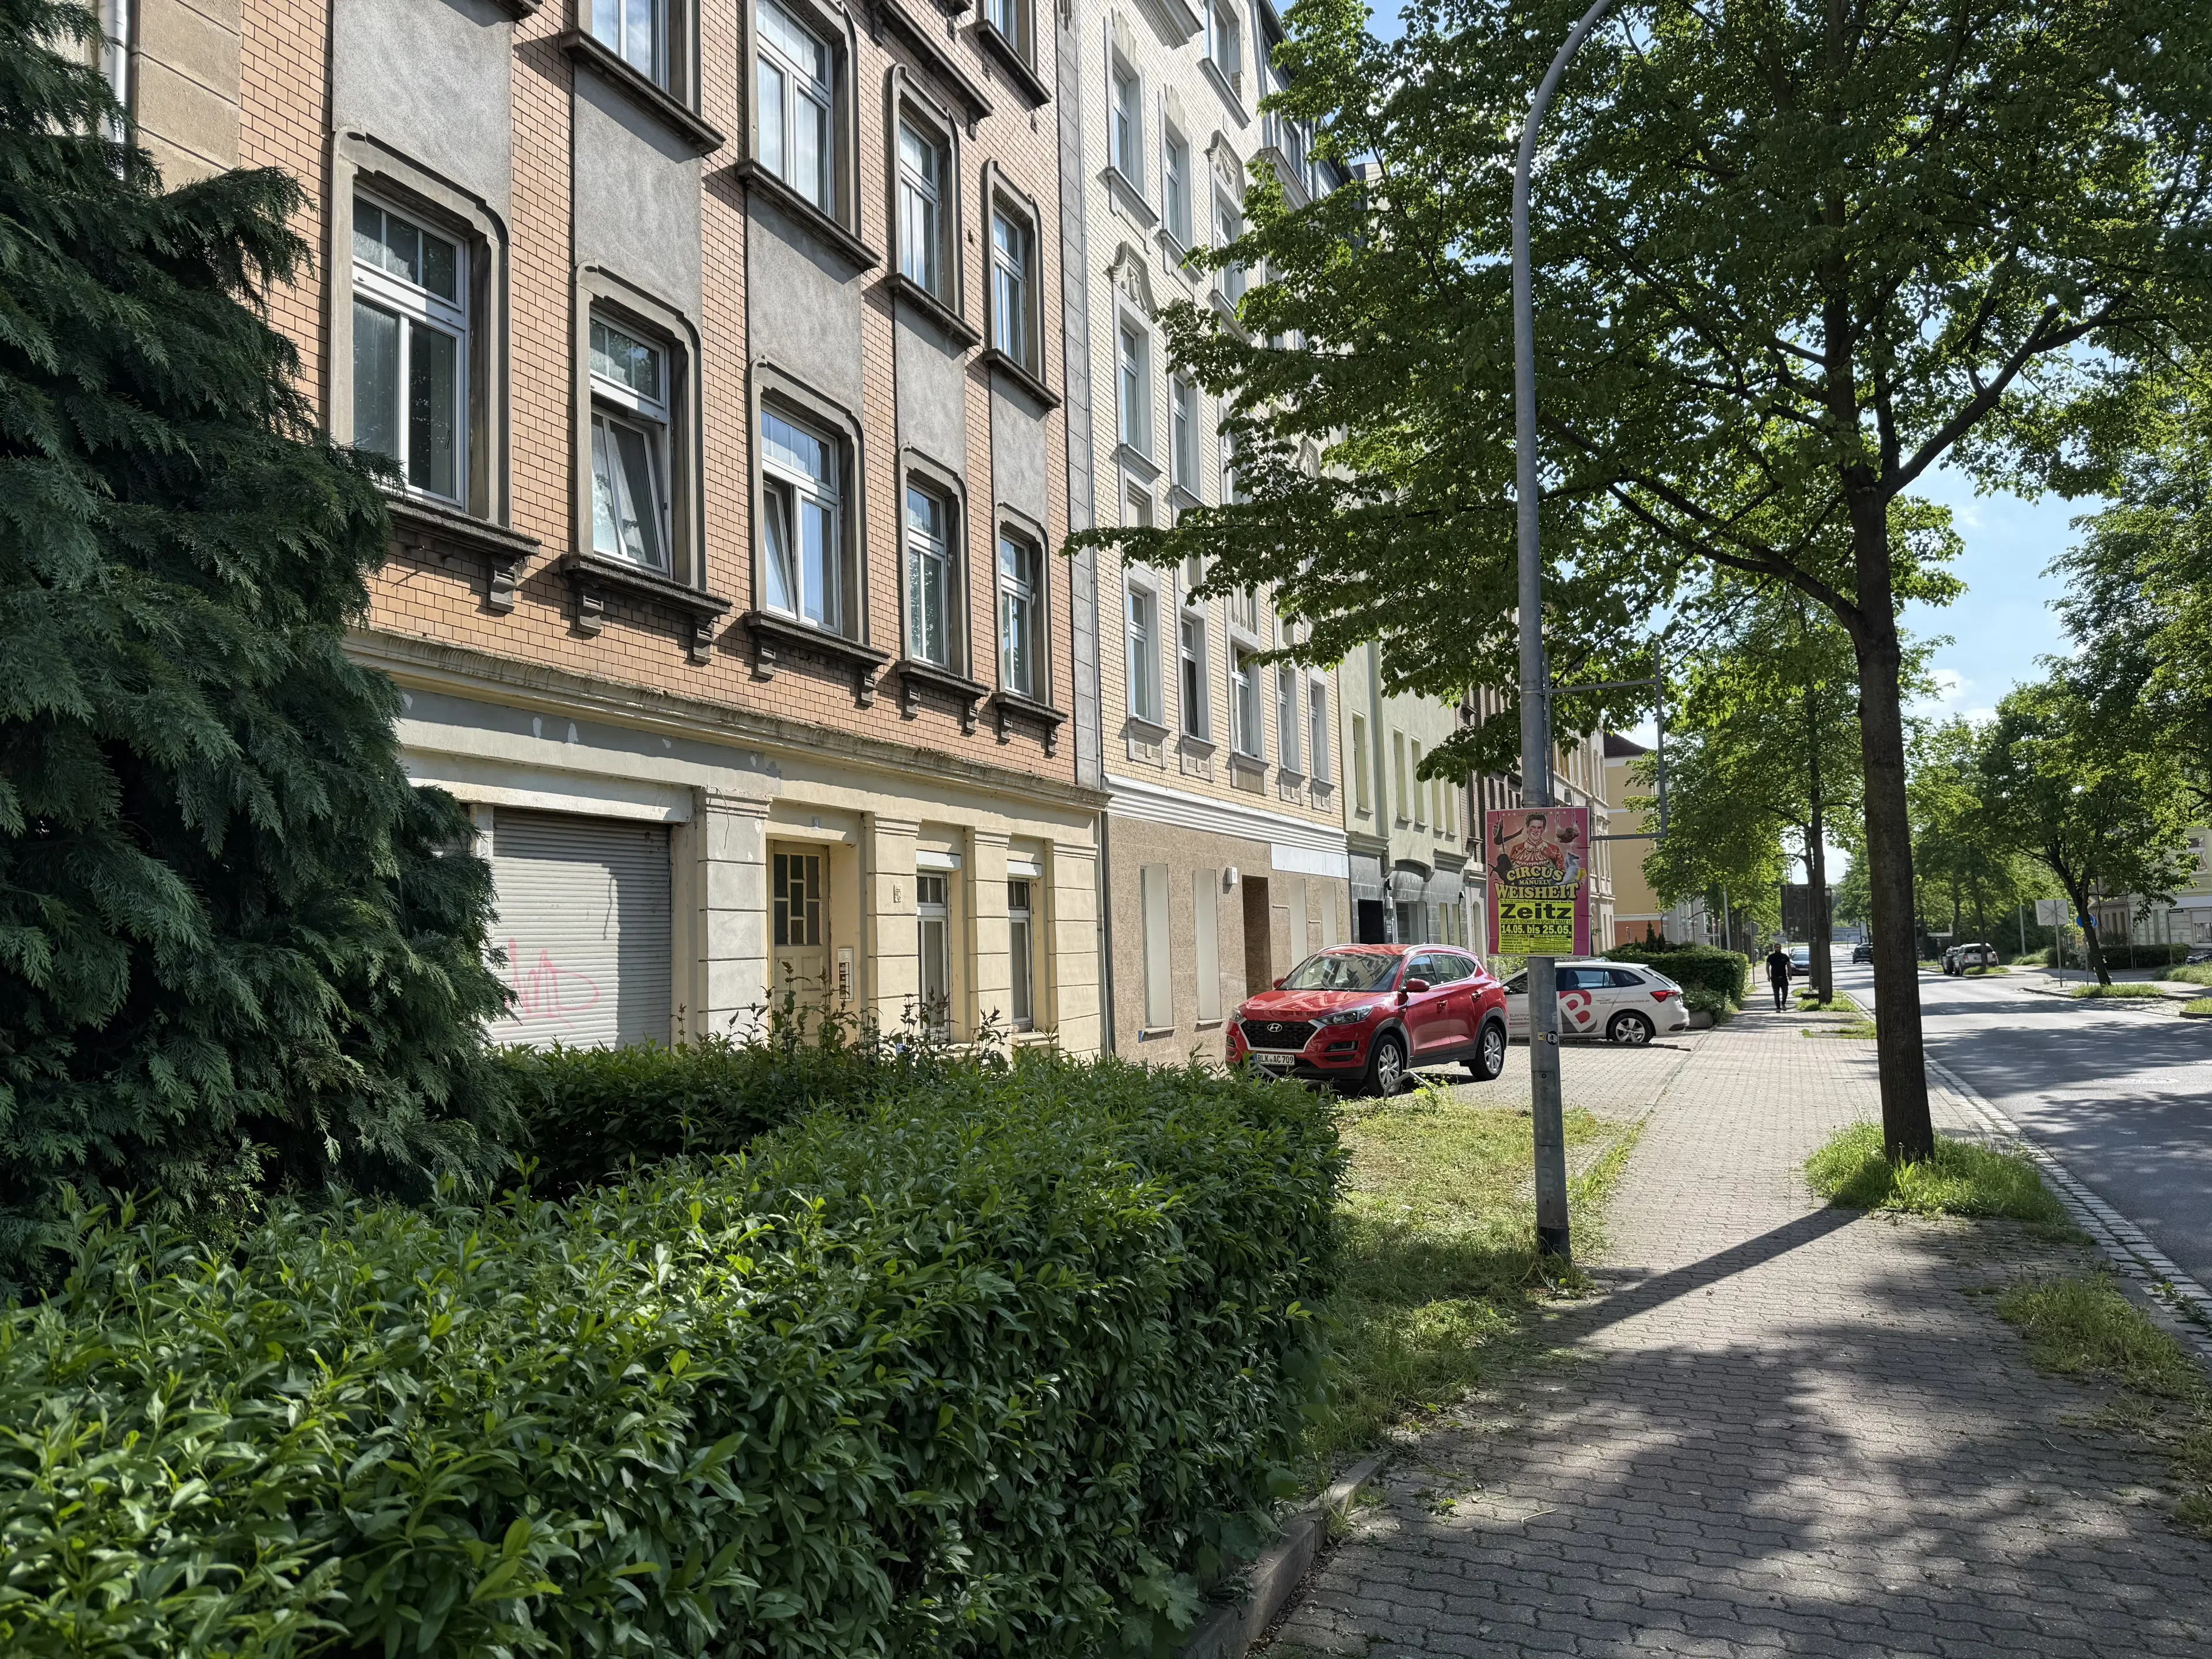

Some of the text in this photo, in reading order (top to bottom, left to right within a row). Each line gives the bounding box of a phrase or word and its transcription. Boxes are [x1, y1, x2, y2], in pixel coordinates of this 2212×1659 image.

[1506, 866, 1564, 881] CIRCUS
[1494, 882, 1579, 899] WEISHEIT
[1501, 903, 1572, 919] Zeitz
[1501, 925, 1572, 934] 14.05. bis 25.05.
[1257, 1054, 1294, 1064] BLK AC 709
